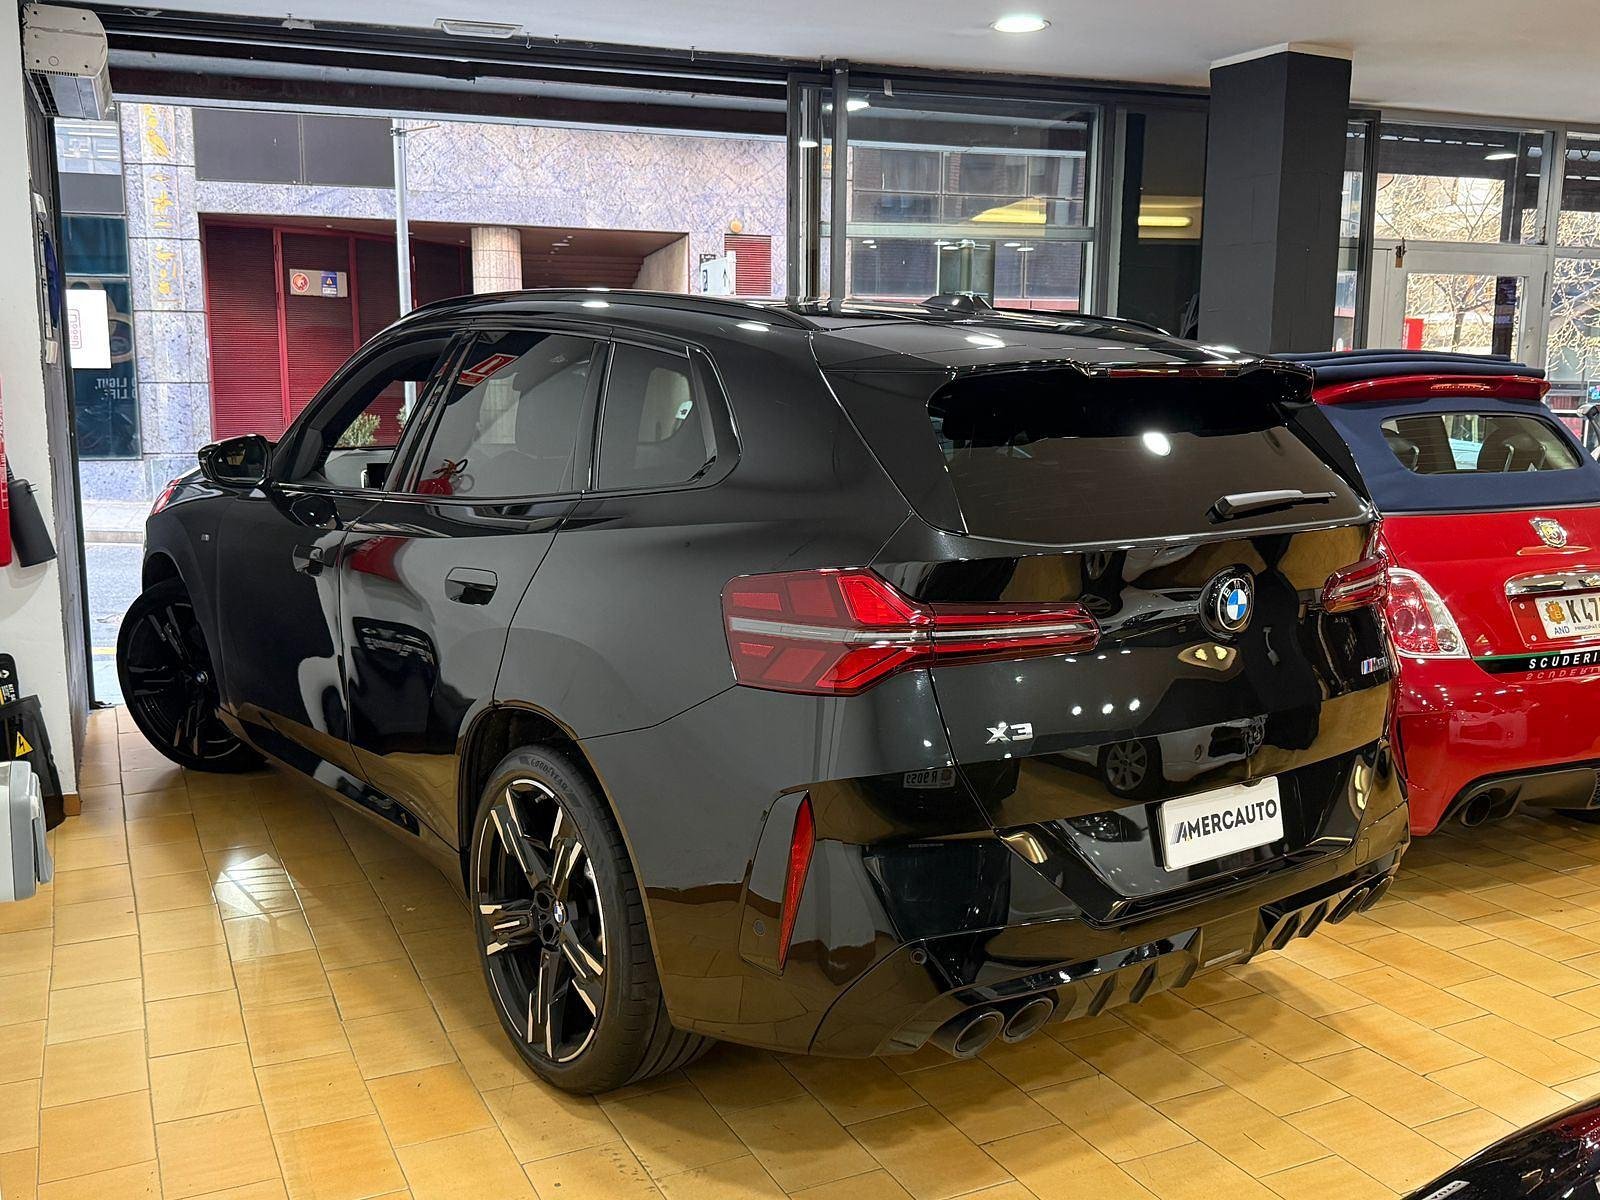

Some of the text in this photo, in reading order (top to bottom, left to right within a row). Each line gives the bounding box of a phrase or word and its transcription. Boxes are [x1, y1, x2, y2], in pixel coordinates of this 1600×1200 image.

[1566, 597, 1600, 623] K47
[1554, 626, 1570, 635] AND
[985, 722, 1033, 744] X3
